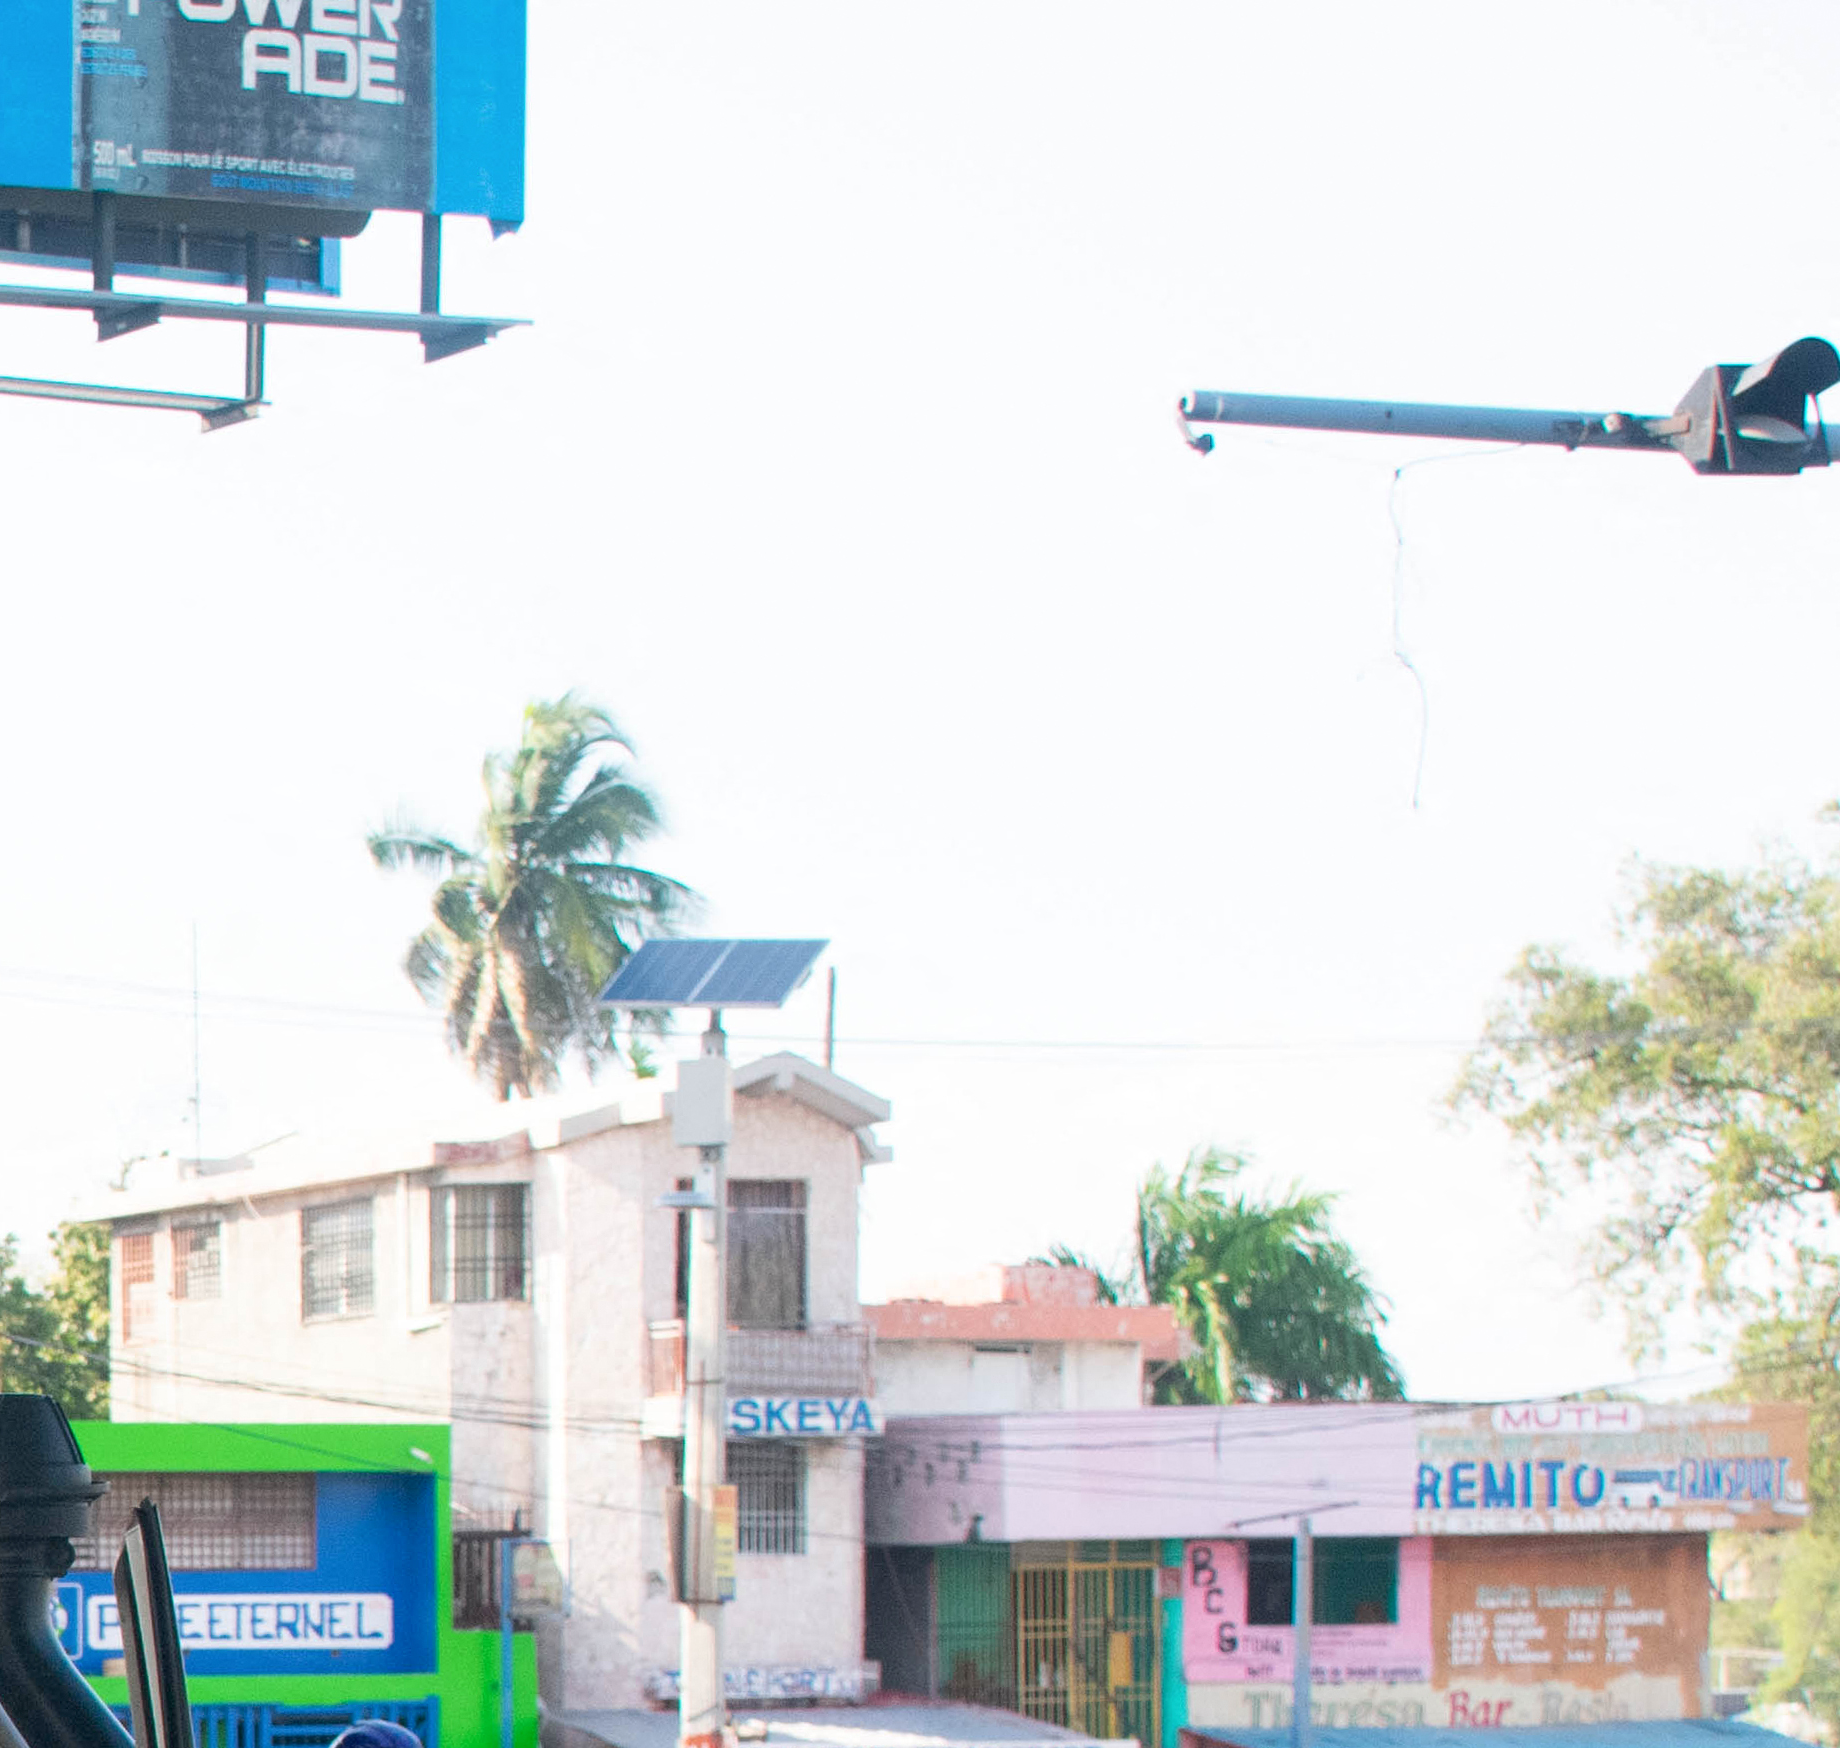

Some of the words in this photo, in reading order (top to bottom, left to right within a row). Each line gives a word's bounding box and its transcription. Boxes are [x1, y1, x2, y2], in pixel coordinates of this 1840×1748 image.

[241, 29, 405, 105] ADE
[731, 1398, 874, 1435] SKEYA
[1500, 1406, 1629, 1429] MUTH
[1415, 1459, 1605, 1510] REMITO
[97, 1602, 203, 1640] PE
[208, 1601, 384, 1640] ETERNEL
